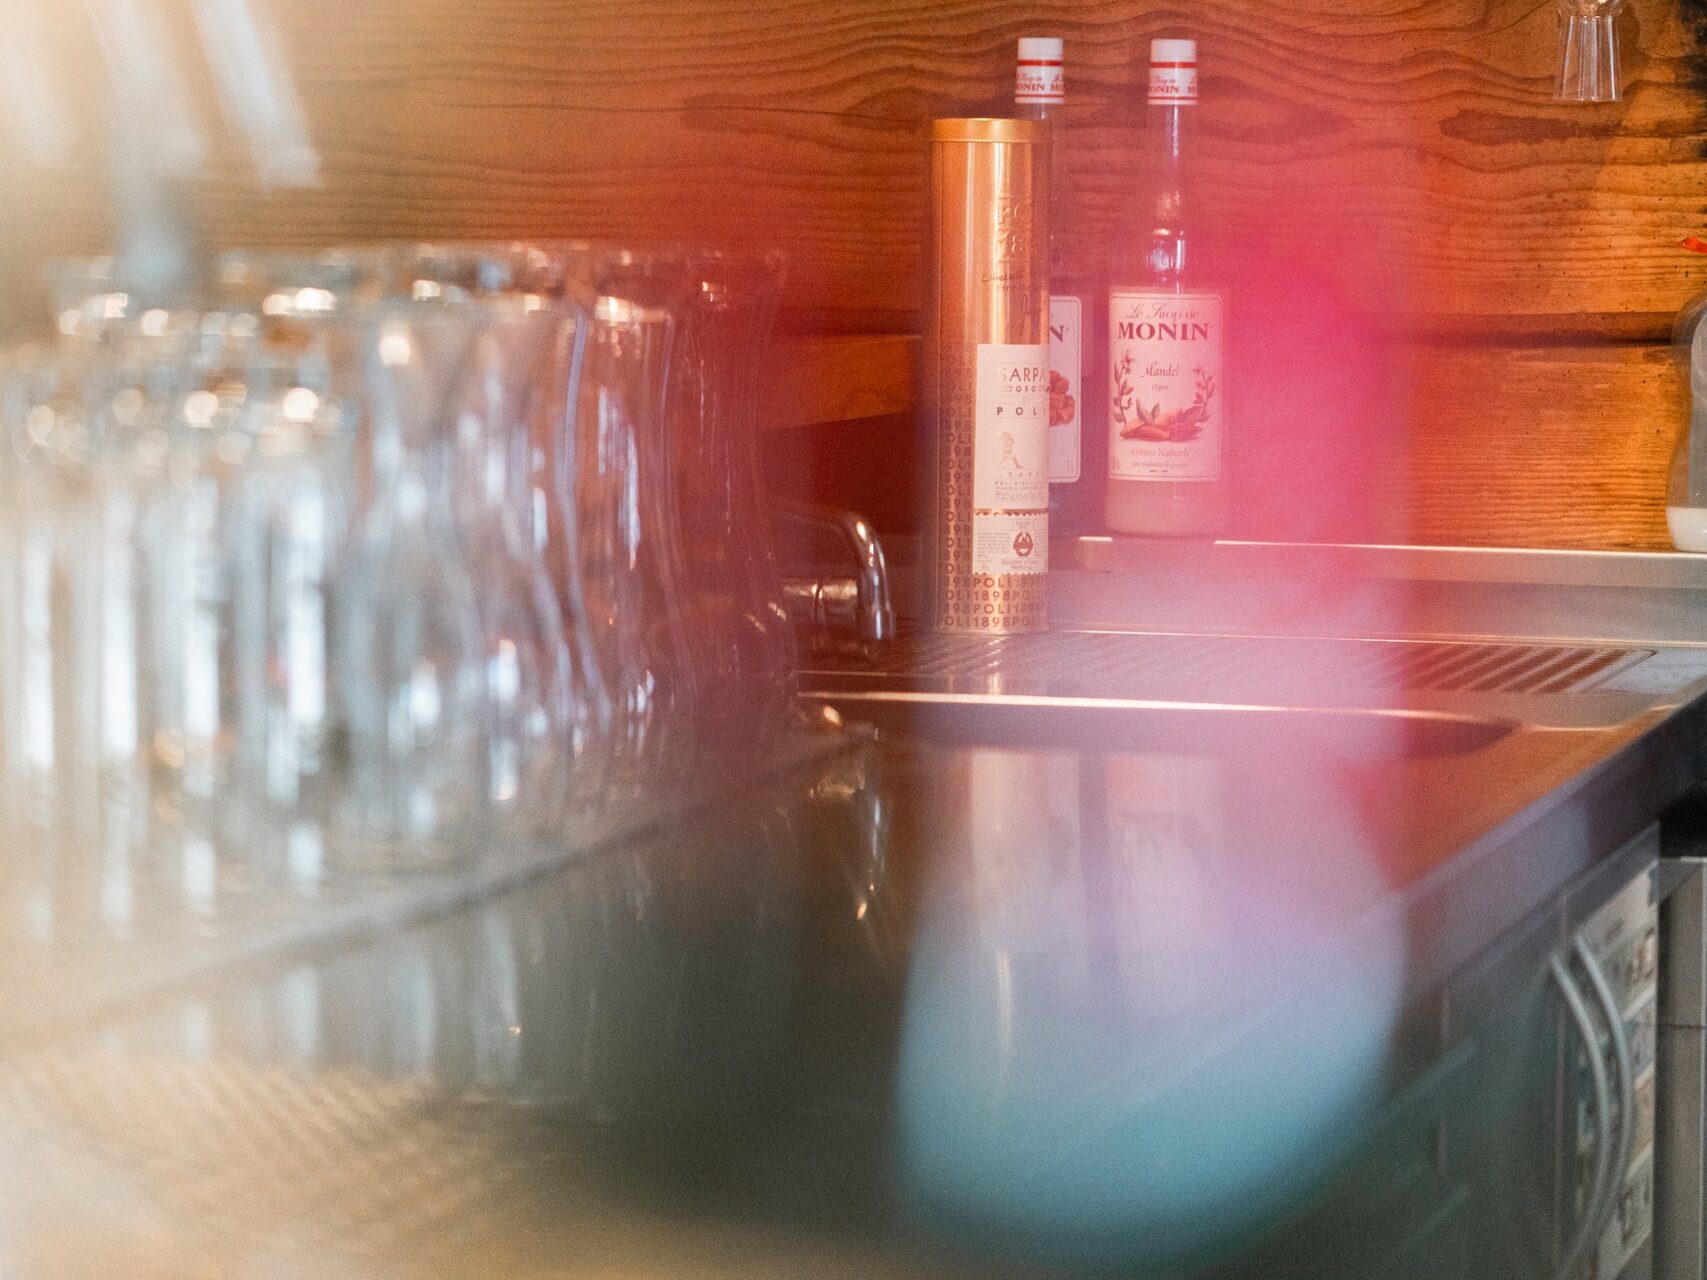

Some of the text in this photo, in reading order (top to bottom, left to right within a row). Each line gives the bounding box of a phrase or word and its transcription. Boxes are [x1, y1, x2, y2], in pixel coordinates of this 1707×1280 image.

[1016, 83, 1045, 92] ONIN
[1150, 85, 1179, 94] ONIN
[1117, 322, 1209, 341] MONIN
[1139, 360, 1180, 379] Mandel
